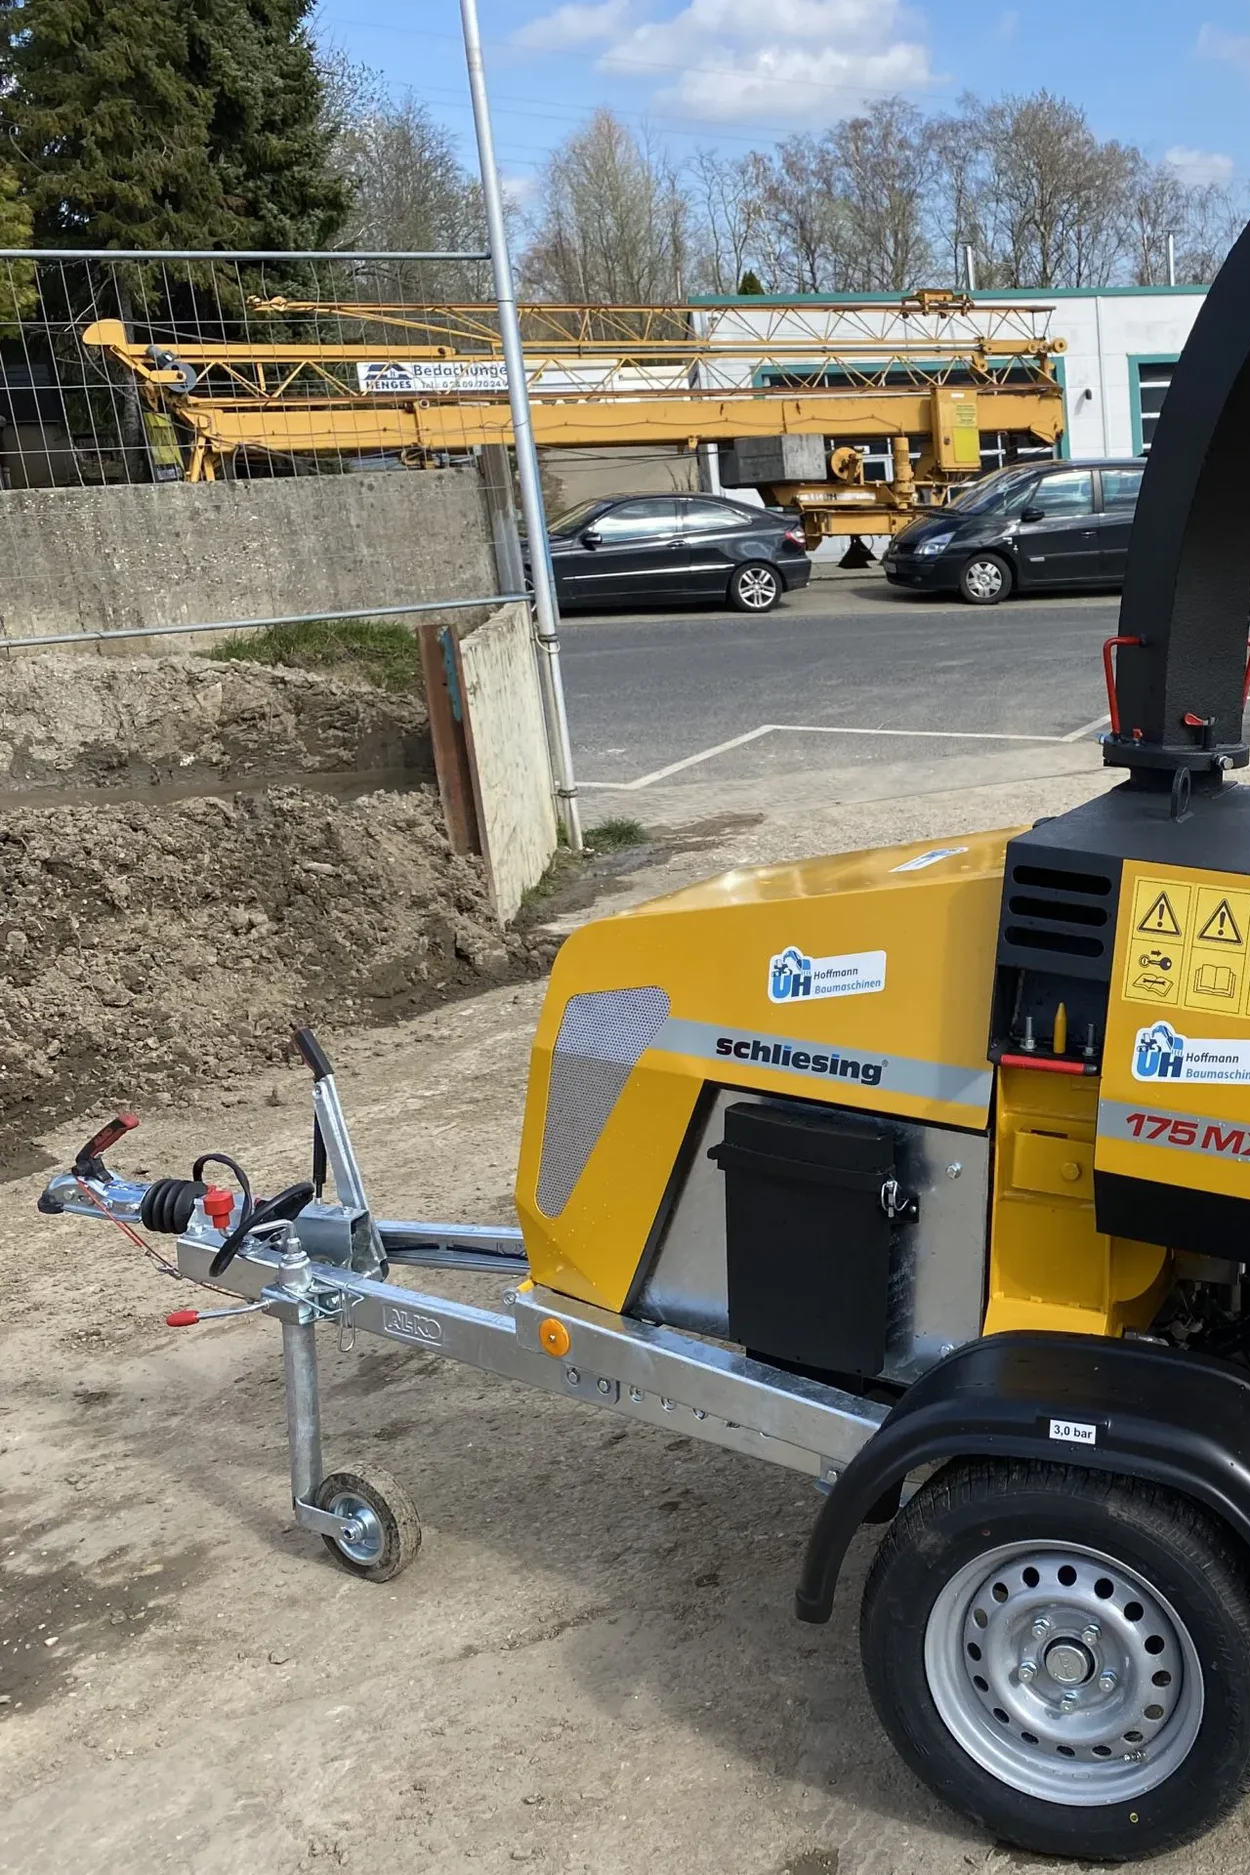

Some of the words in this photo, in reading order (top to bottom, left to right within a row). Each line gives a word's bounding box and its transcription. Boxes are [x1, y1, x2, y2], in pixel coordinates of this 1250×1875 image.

[414, 363, 508, 378] Bedachunge
[366, 380, 412, 390] HENGES
[813, 968, 858, 980] Hoffmann
[814, 979, 881, 994] Baumaschinen
[1186, 1052, 1239, 1064] Hoffmann
[1053, 1424, 1071, 1437] 3,0
[1073, 1427, 1093, 1439] bar
